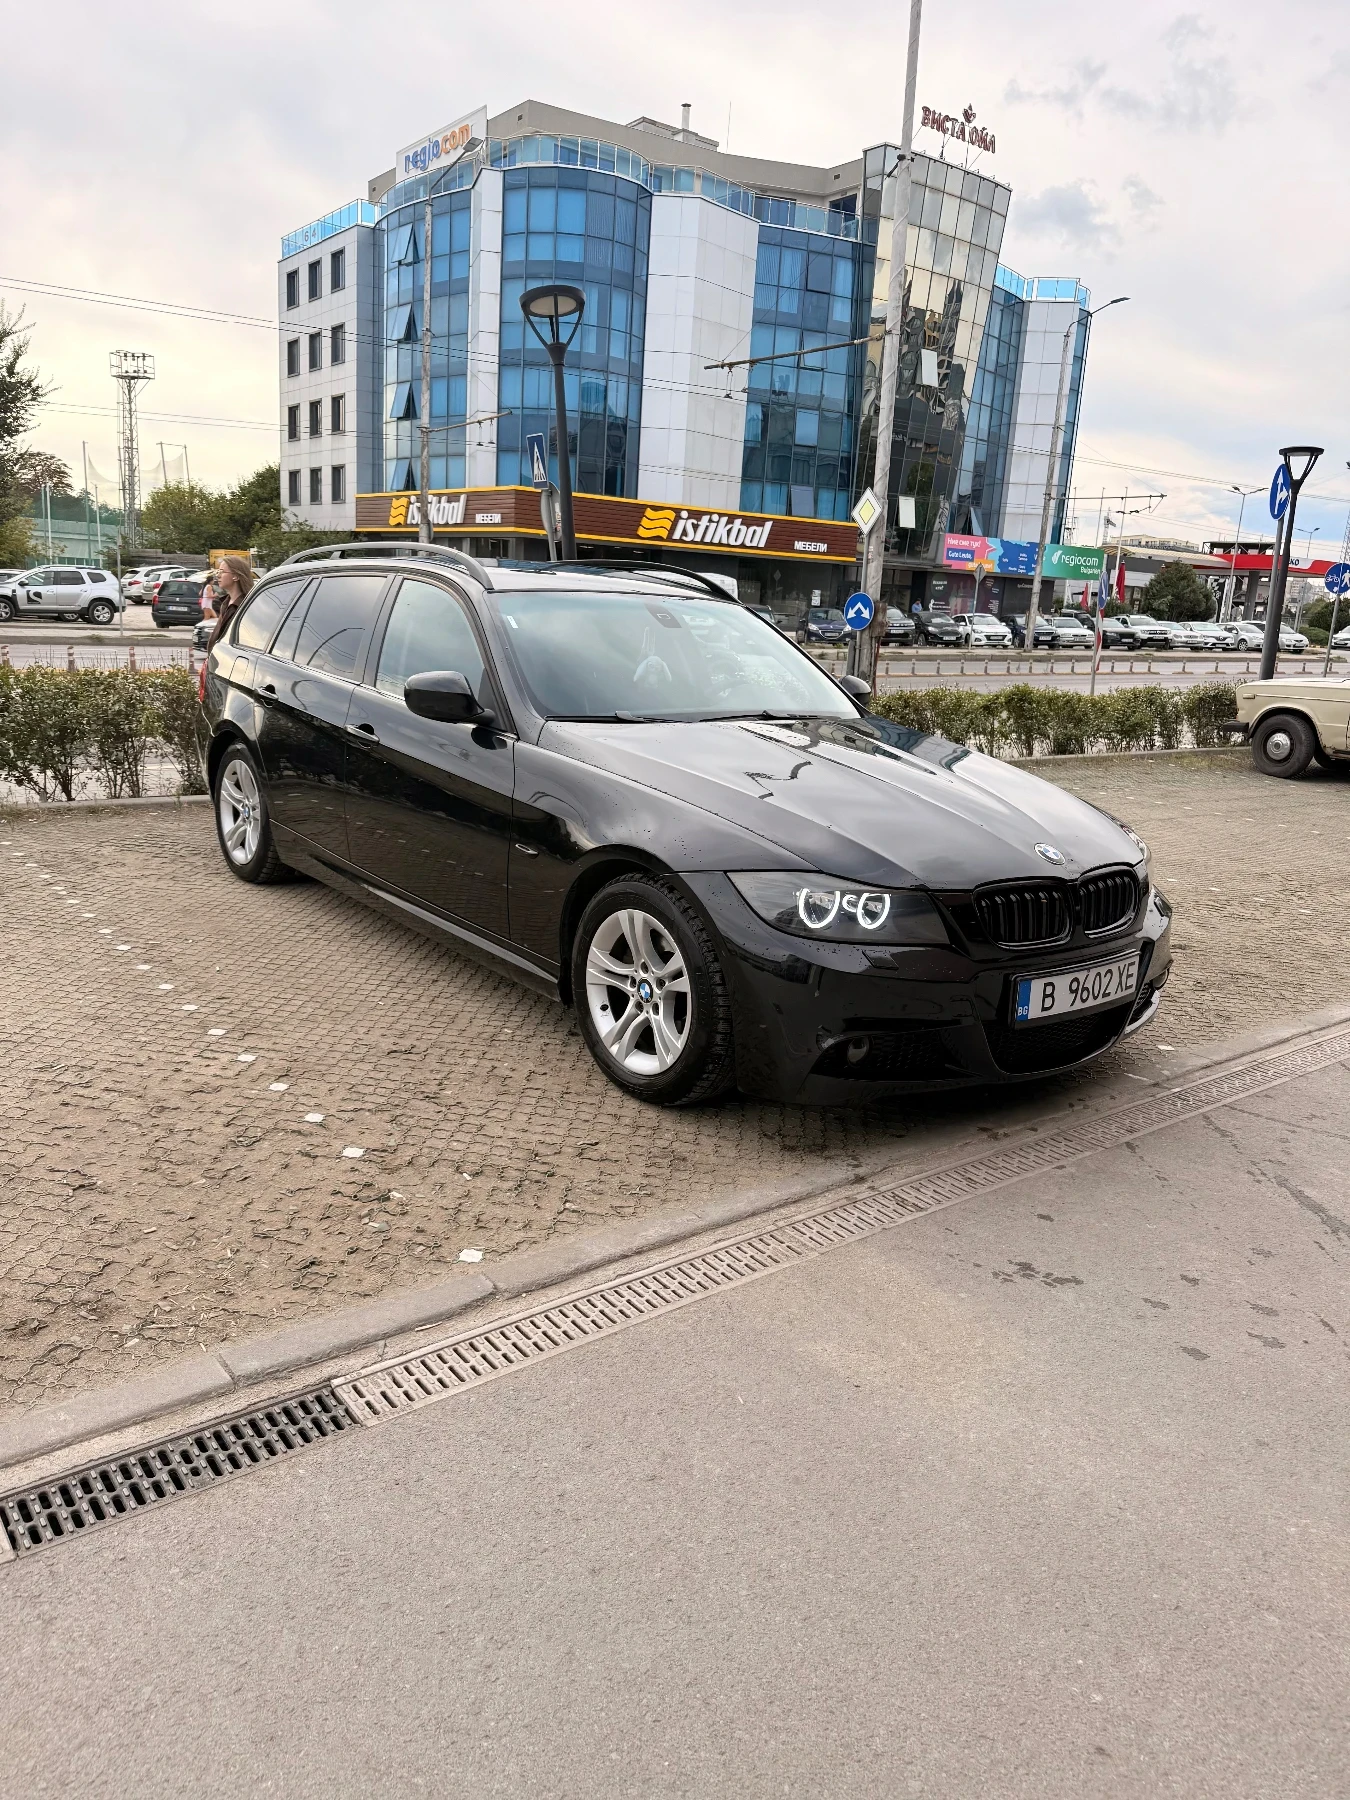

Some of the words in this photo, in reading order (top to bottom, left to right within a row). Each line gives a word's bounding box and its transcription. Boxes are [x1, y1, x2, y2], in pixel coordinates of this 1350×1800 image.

[921, 106, 966, 142] ВИСТА
[969, 126, 996, 154] ОЙЛ
[405, 124, 470, 173] regiocom
[407, 494, 467, 525] isikbal
[672, 510, 773, 548] istikbal
[794, 540, 827, 553] МЕБЕЛИ
[1061, 553, 1099, 567] regiocom
[1080, 566, 1101, 575] Bulgarien
[1040, 981, 1056, 1012] B
[1068, 969, 1114, 1007] 9602
[1115, 961, 1136, 993] XE
[1017, 1005, 1028, 1016] BG
